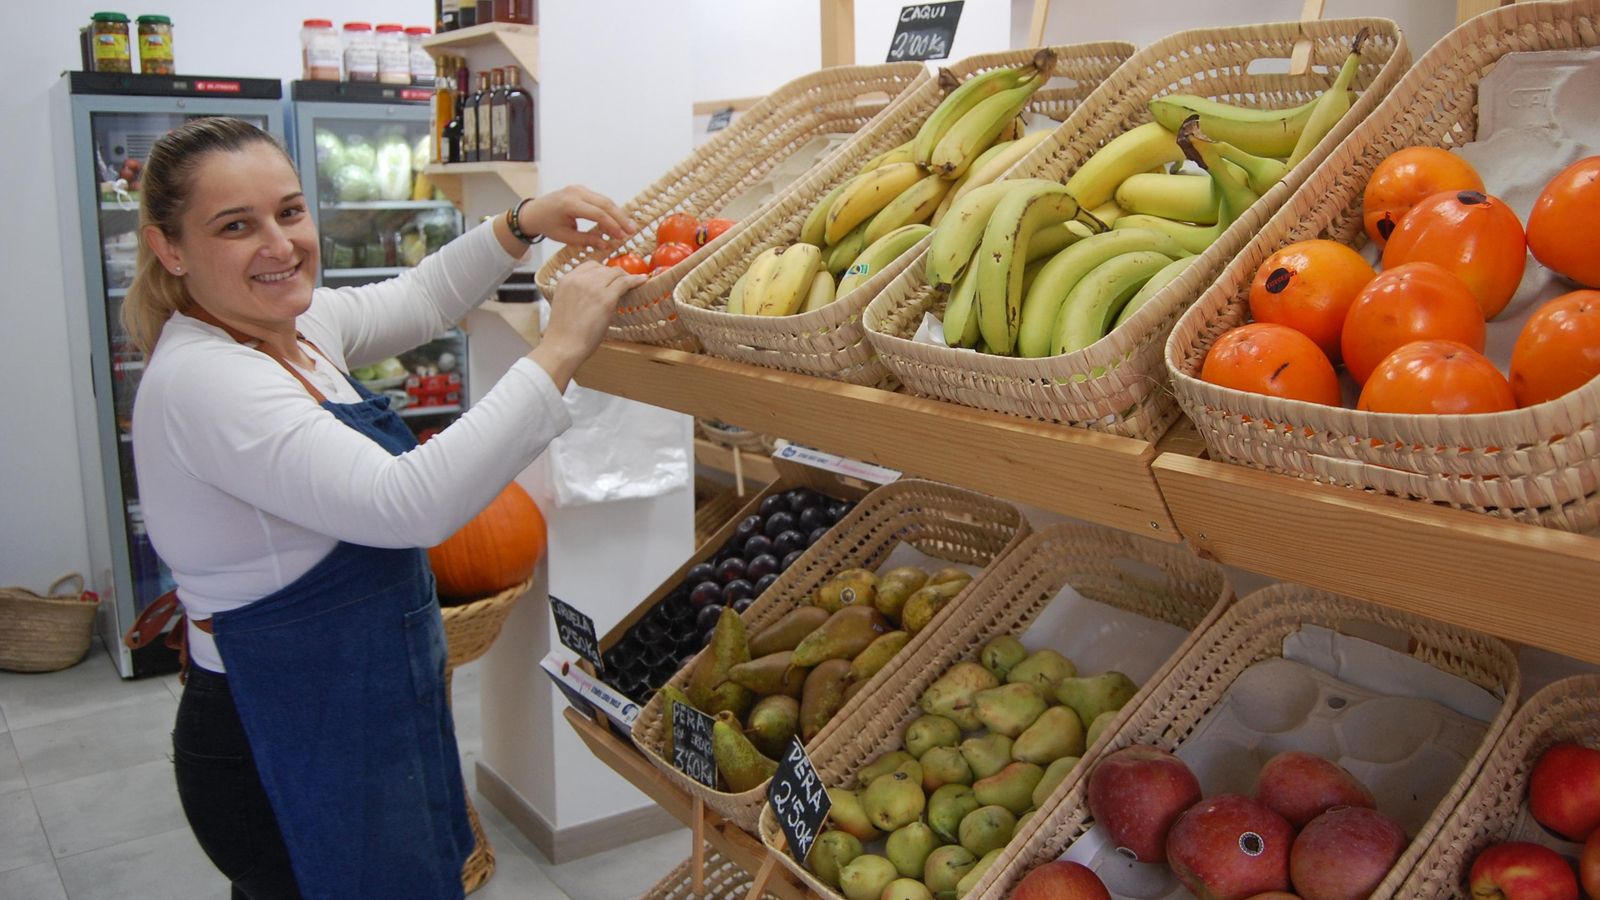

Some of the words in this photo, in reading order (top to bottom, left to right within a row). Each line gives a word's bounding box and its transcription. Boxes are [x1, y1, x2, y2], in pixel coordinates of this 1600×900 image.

[900, 5, 946, 23] CAQUI
[673, 702, 706, 732] PERA
[788, 741, 822, 813] PERA
